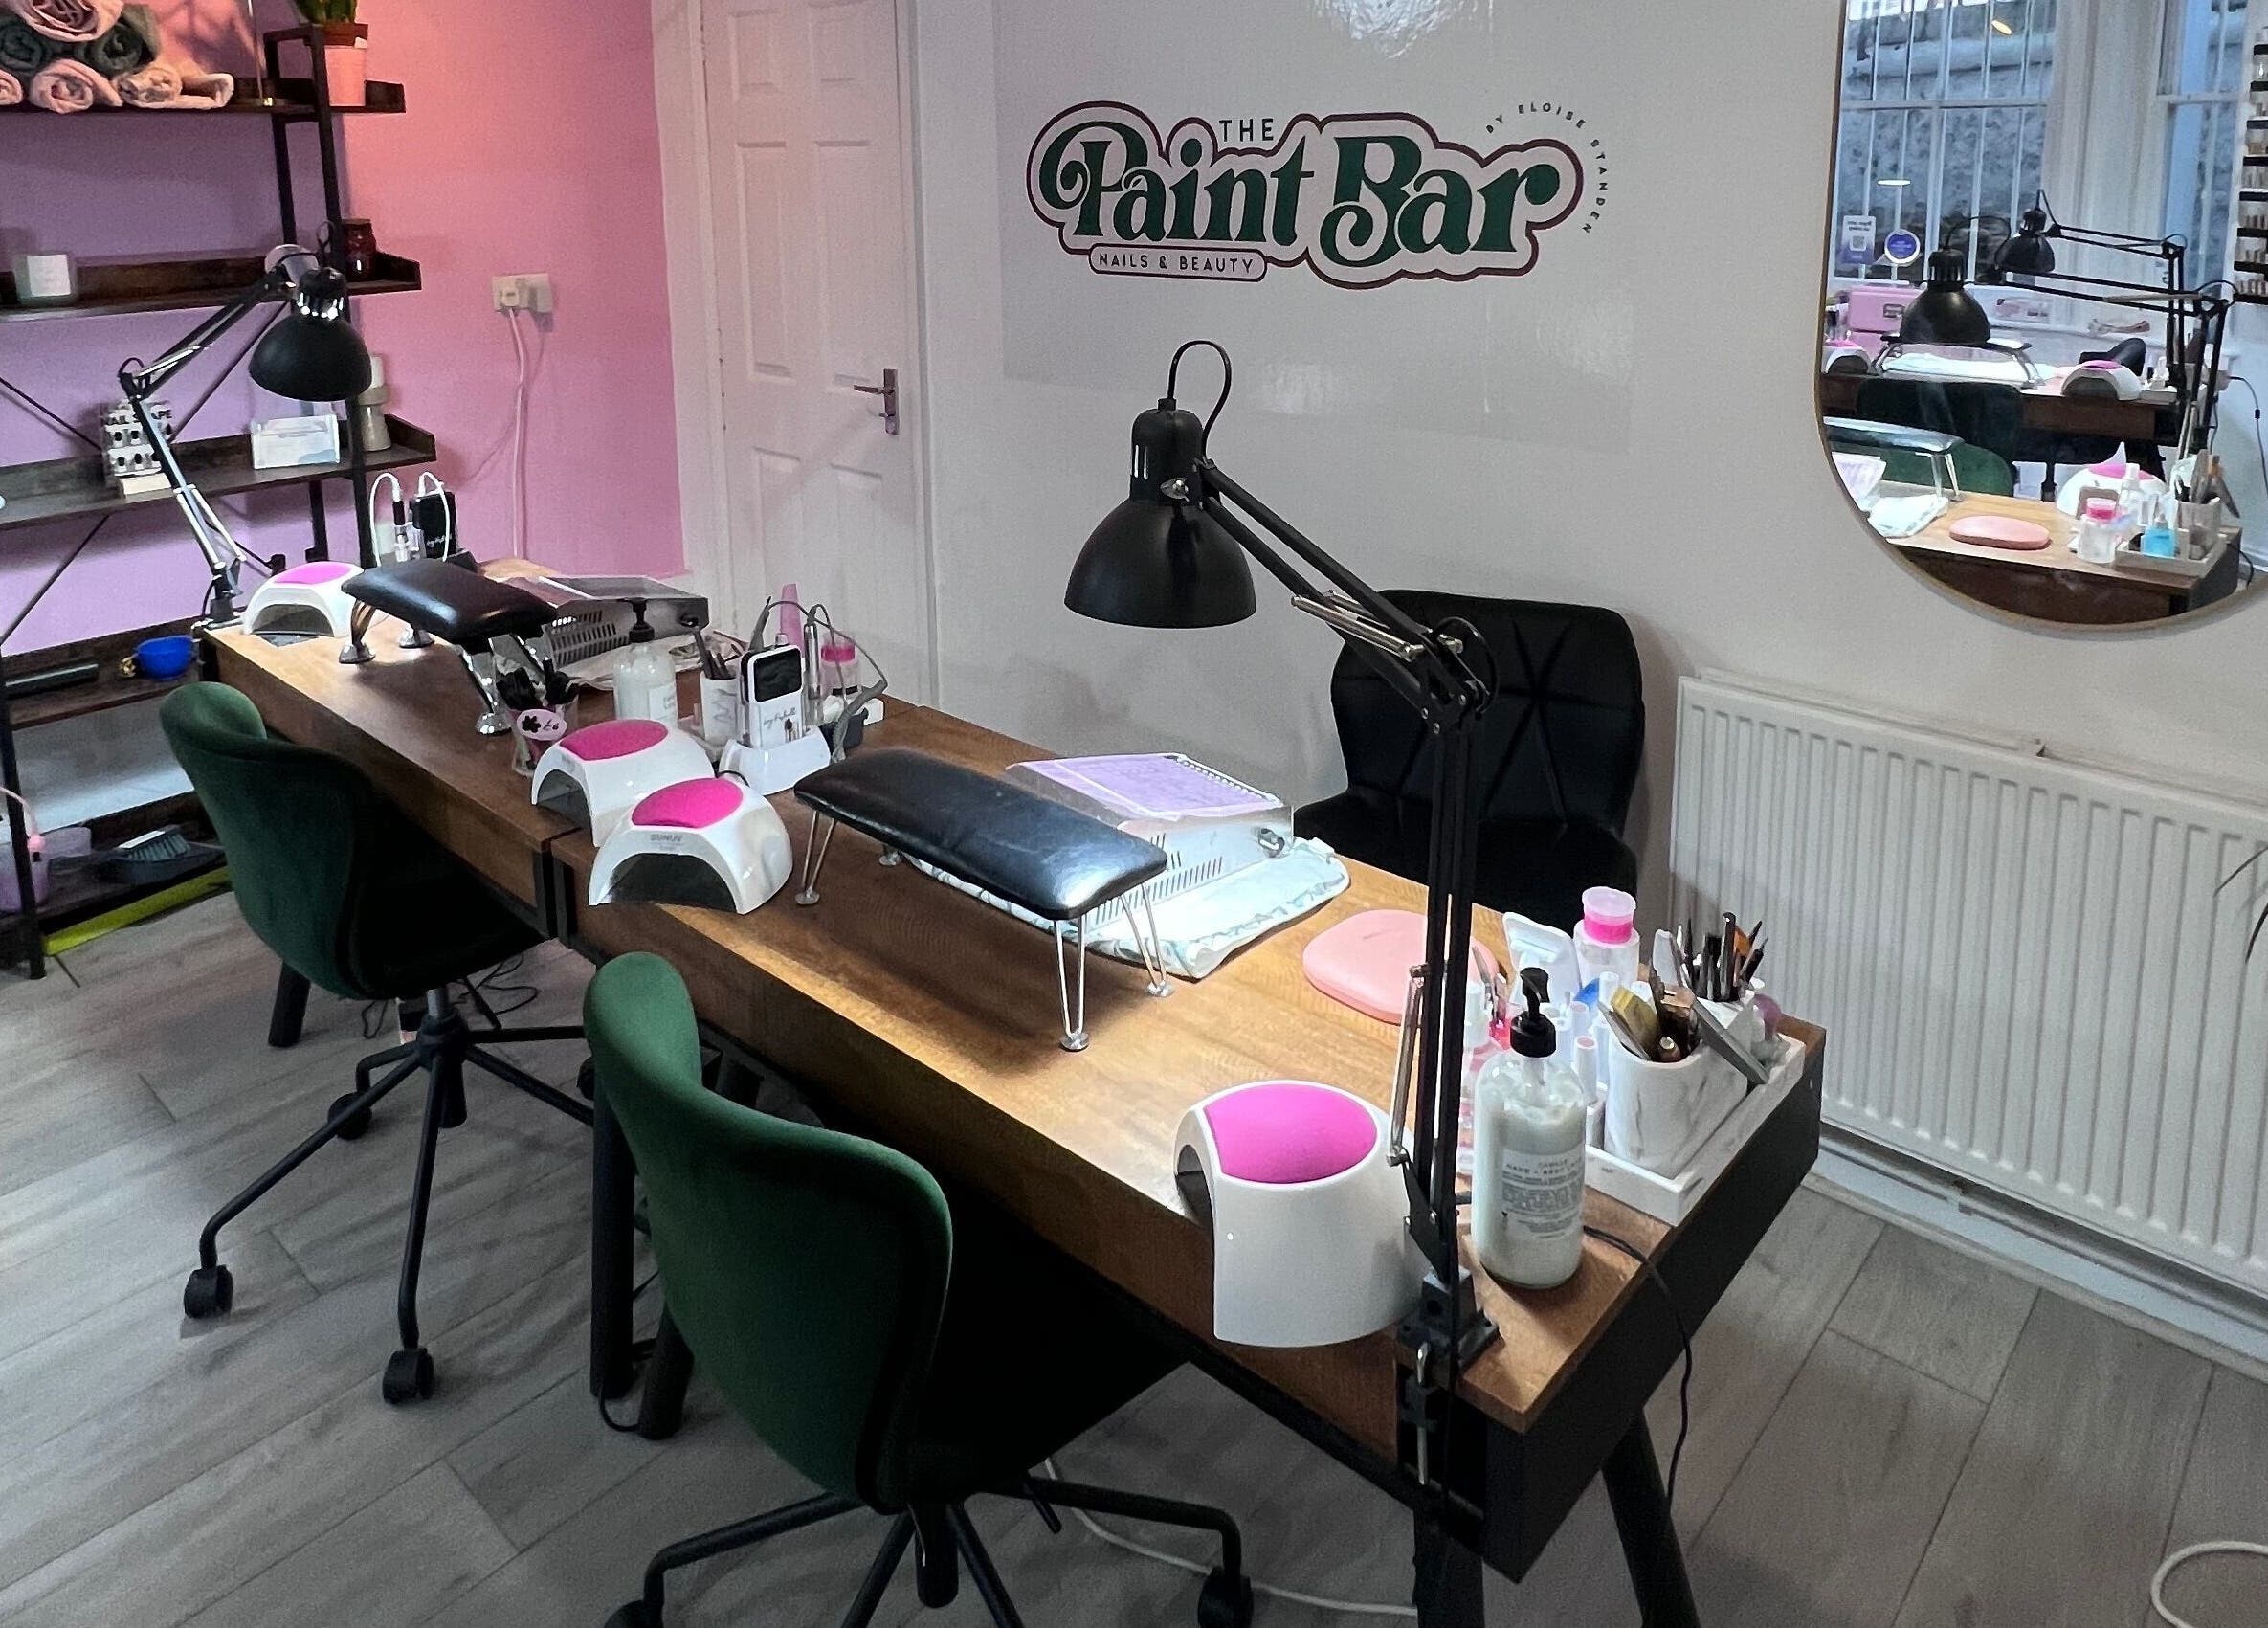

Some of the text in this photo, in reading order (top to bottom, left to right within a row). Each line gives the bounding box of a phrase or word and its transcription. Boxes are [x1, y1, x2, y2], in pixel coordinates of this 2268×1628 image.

[1218, 118, 1275, 143] THE
[1485, 101, 1609, 234] BY ELOISE STANDEN
[1038, 120, 1561, 268] Paint Bar
[1099, 253, 1255, 274] NAILS & BEAUTY
